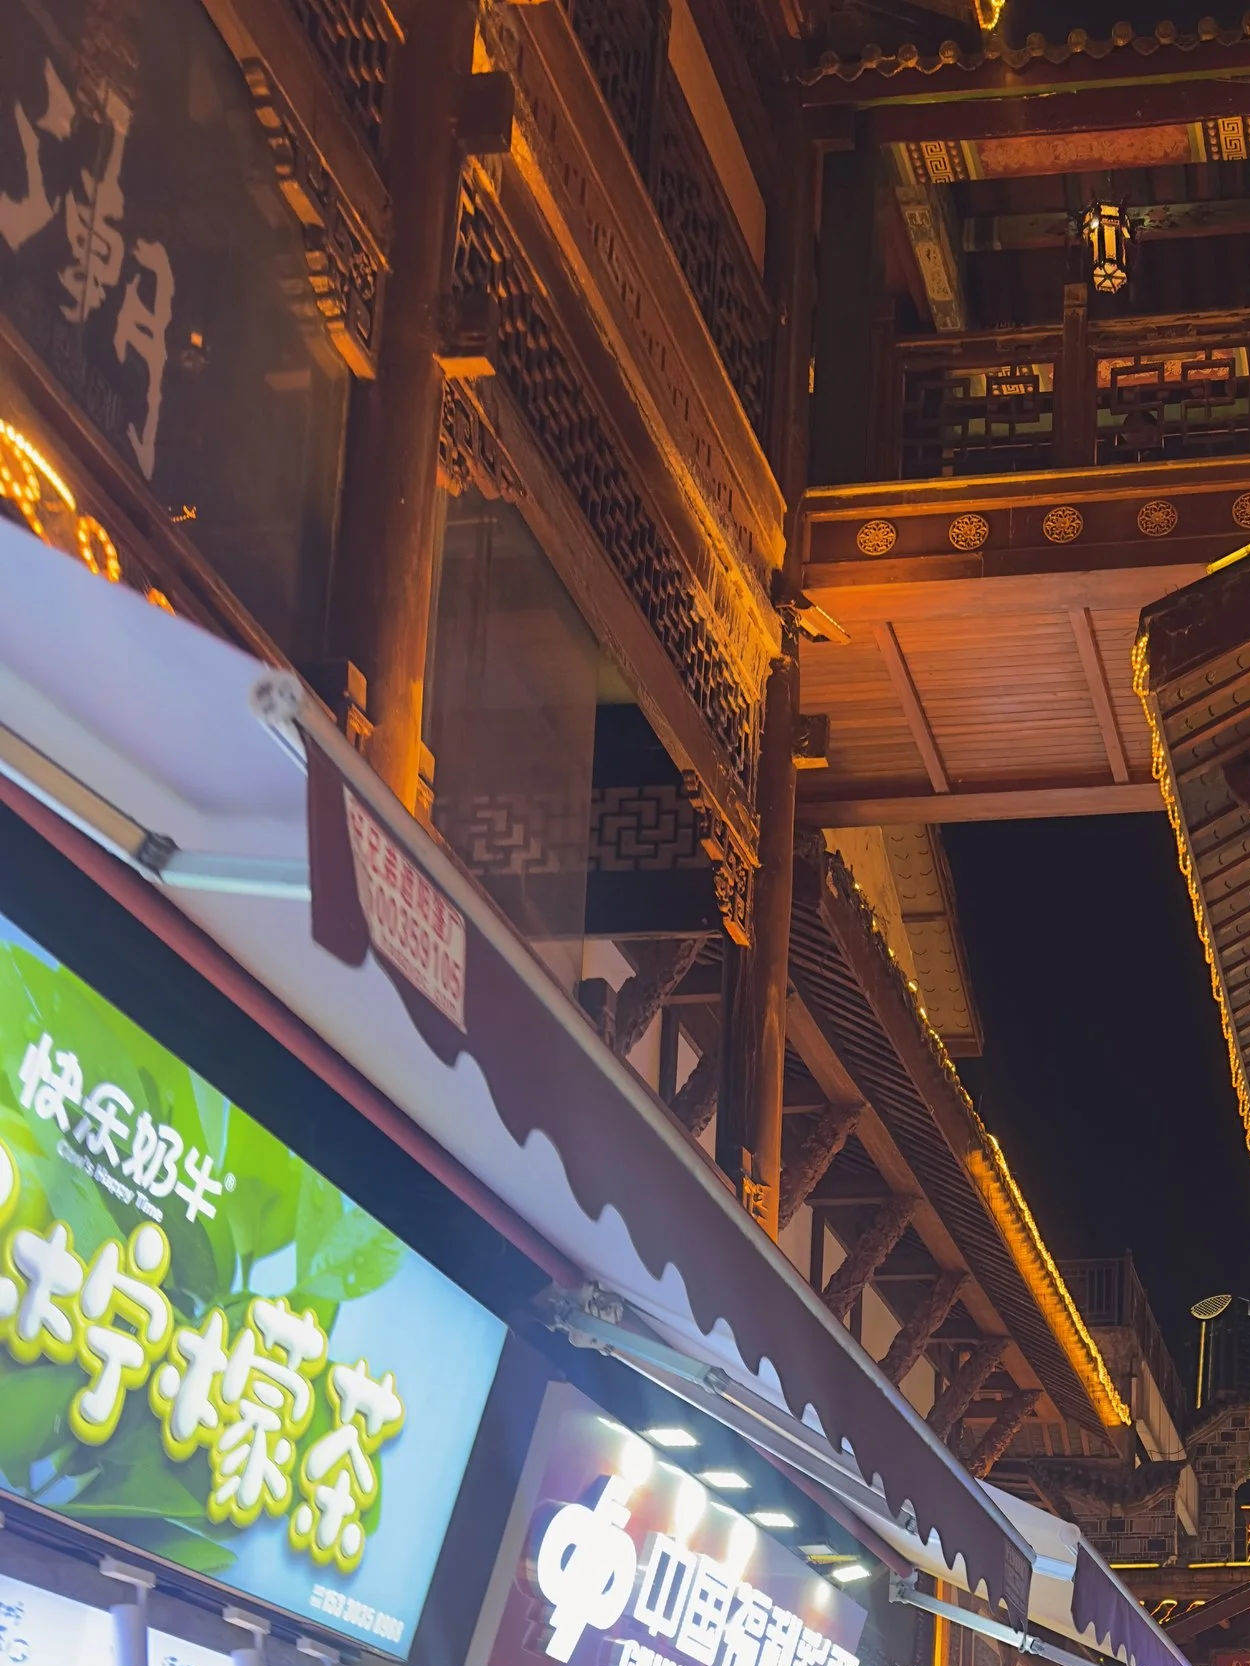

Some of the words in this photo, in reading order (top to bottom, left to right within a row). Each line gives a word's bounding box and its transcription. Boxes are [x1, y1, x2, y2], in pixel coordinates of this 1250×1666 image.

[18, 1032, 223, 1223] 快乐奶牛
[135, 1190, 164, 1223] Time
[0, 1224, 402, 1558] 柠檬茶
